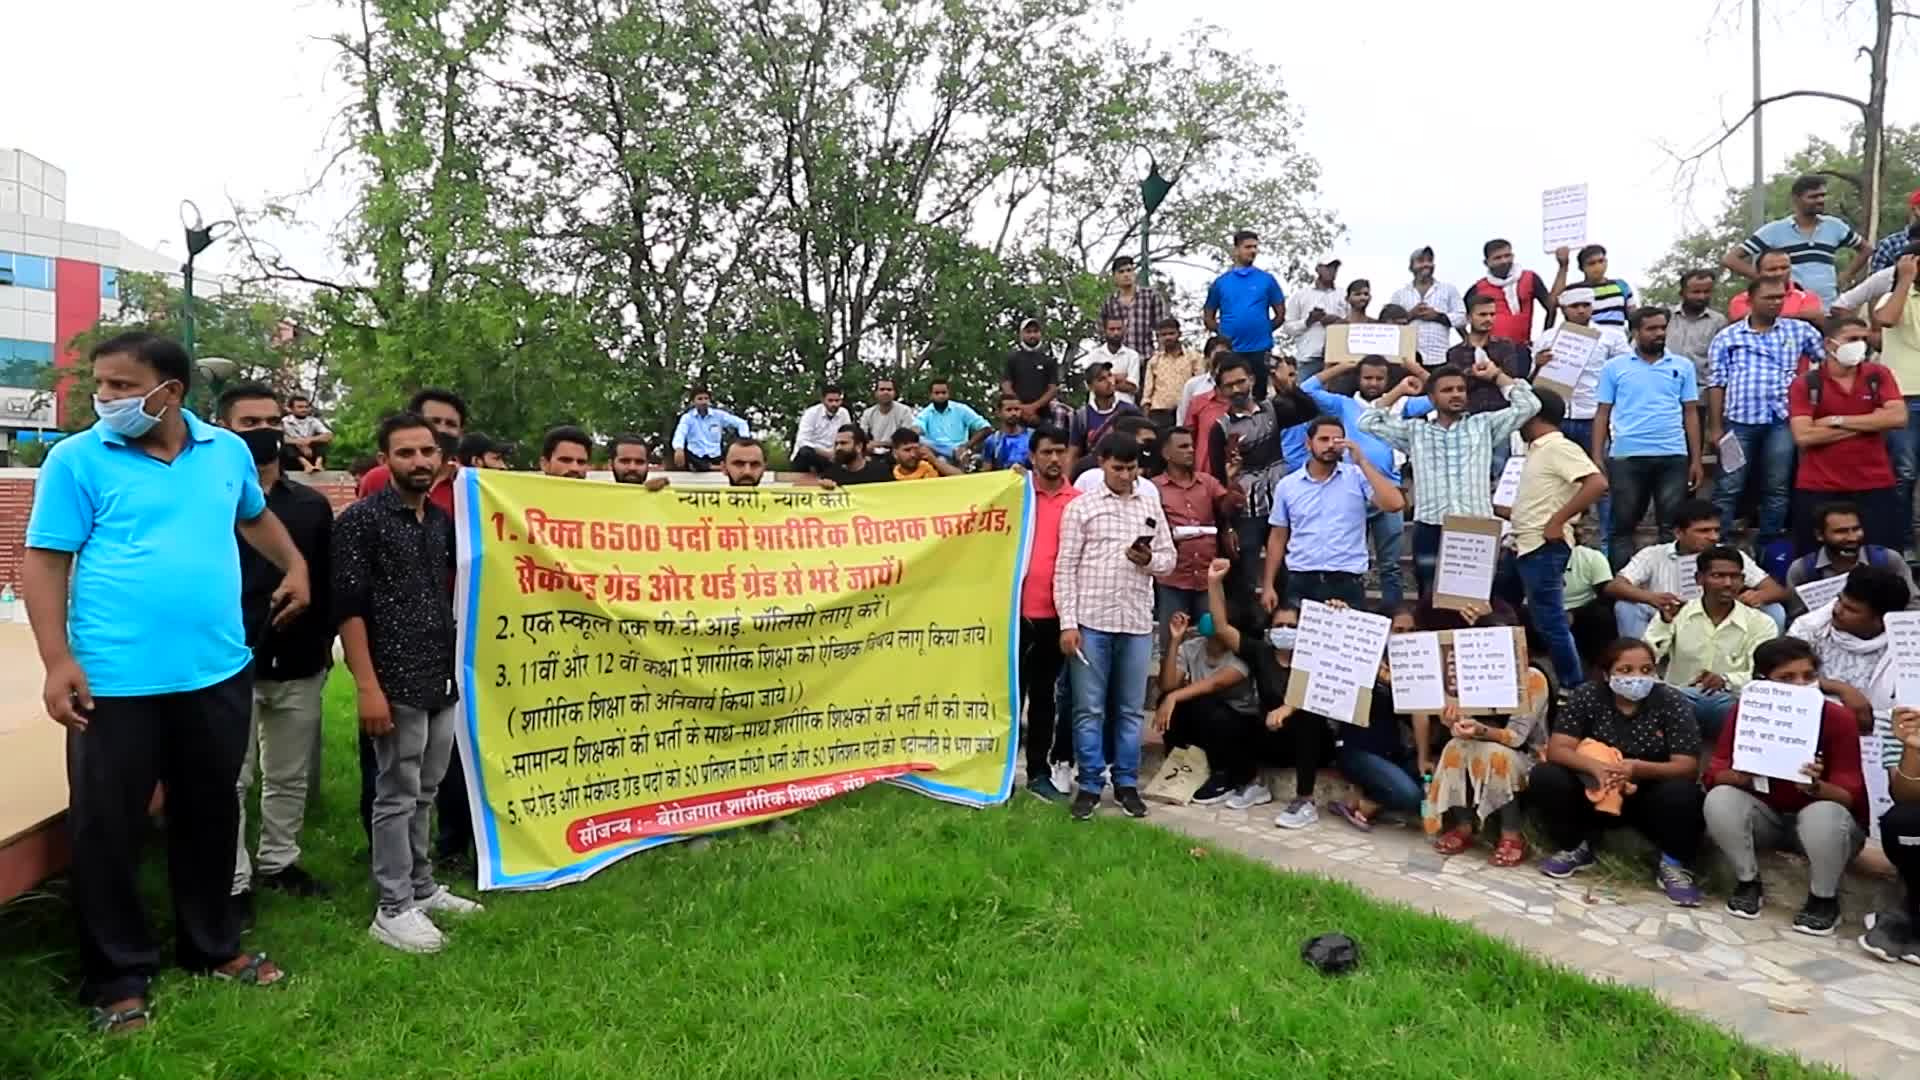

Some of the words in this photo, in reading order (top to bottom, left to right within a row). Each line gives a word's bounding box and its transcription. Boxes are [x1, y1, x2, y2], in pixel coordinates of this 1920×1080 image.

[491, 511, 518, 541] 1.
[590, 521, 661, 551] 6500
[666, 517, 713, 551] पदों
[716, 517, 750, 551] को
[753, 517, 848, 550] शारीरिक
[852, 515, 928, 545] शिक्षक
[604, 564, 641, 604] ग्रेड
[649, 565, 695, 602] और
[701, 563, 737, 600] थर्ड
[742, 561, 778, 599] ग्रेड
[782, 561, 804, 596] से
[809, 561, 839, 594] भरे
[496, 615, 515, 640] 2.
[521, 611, 554, 644] एक
[558, 609, 613, 640] स्कूल
[751, 605, 817, 633] पॉलिसी
[820, 605, 853, 629] लागू
[496, 663, 512, 687] 3.
[563, 644, 590, 679] और
[595, 652, 615, 674] 12
[643, 658, 678, 679] कक्षा
[681, 646, 694, 678] में
[696, 642, 754, 678] शारीरिक
[758, 642, 793, 671] शिक्षा
[796, 637, 816, 665] को
[898, 628, 926, 656] लागू
[928, 621, 961, 648] किया
[574, 727, 626, 767] शिक्षकों
[629, 724, 651, 756] की
[654, 719, 683, 751] भर्ती
[685, 717, 701, 746] के
[774, 705, 825, 736] शारीरिक
[828, 698, 874, 730] शिक्षकों
[876, 697, 893, 723] की
[895, 695, 921, 721] भर्ती
[924, 693, 939, 720] भी
[942, 692, 960, 720] की
[588, 691, 627, 723] शिक्षा
[629, 684, 652, 715] को
[655, 687, 718, 712] अनिवार्य
[720, 686, 755, 712] किया
[559, 777, 580, 811] और
[642, 761, 664, 795] पदों
[665, 759, 682, 790] को
[684, 765, 699, 787] 50
[701, 754, 738, 786] प्रतिशत
[791, 741, 810, 769] और
[812, 746, 826, 767] 50
[881, 730, 897, 756] को
[577, 815, 634, 849] सौजन्य
[656, 802, 722, 829] बेरोजगार
[725, 788, 787, 819] शारीरिक
[787, 782, 836, 806] शिक्षक
